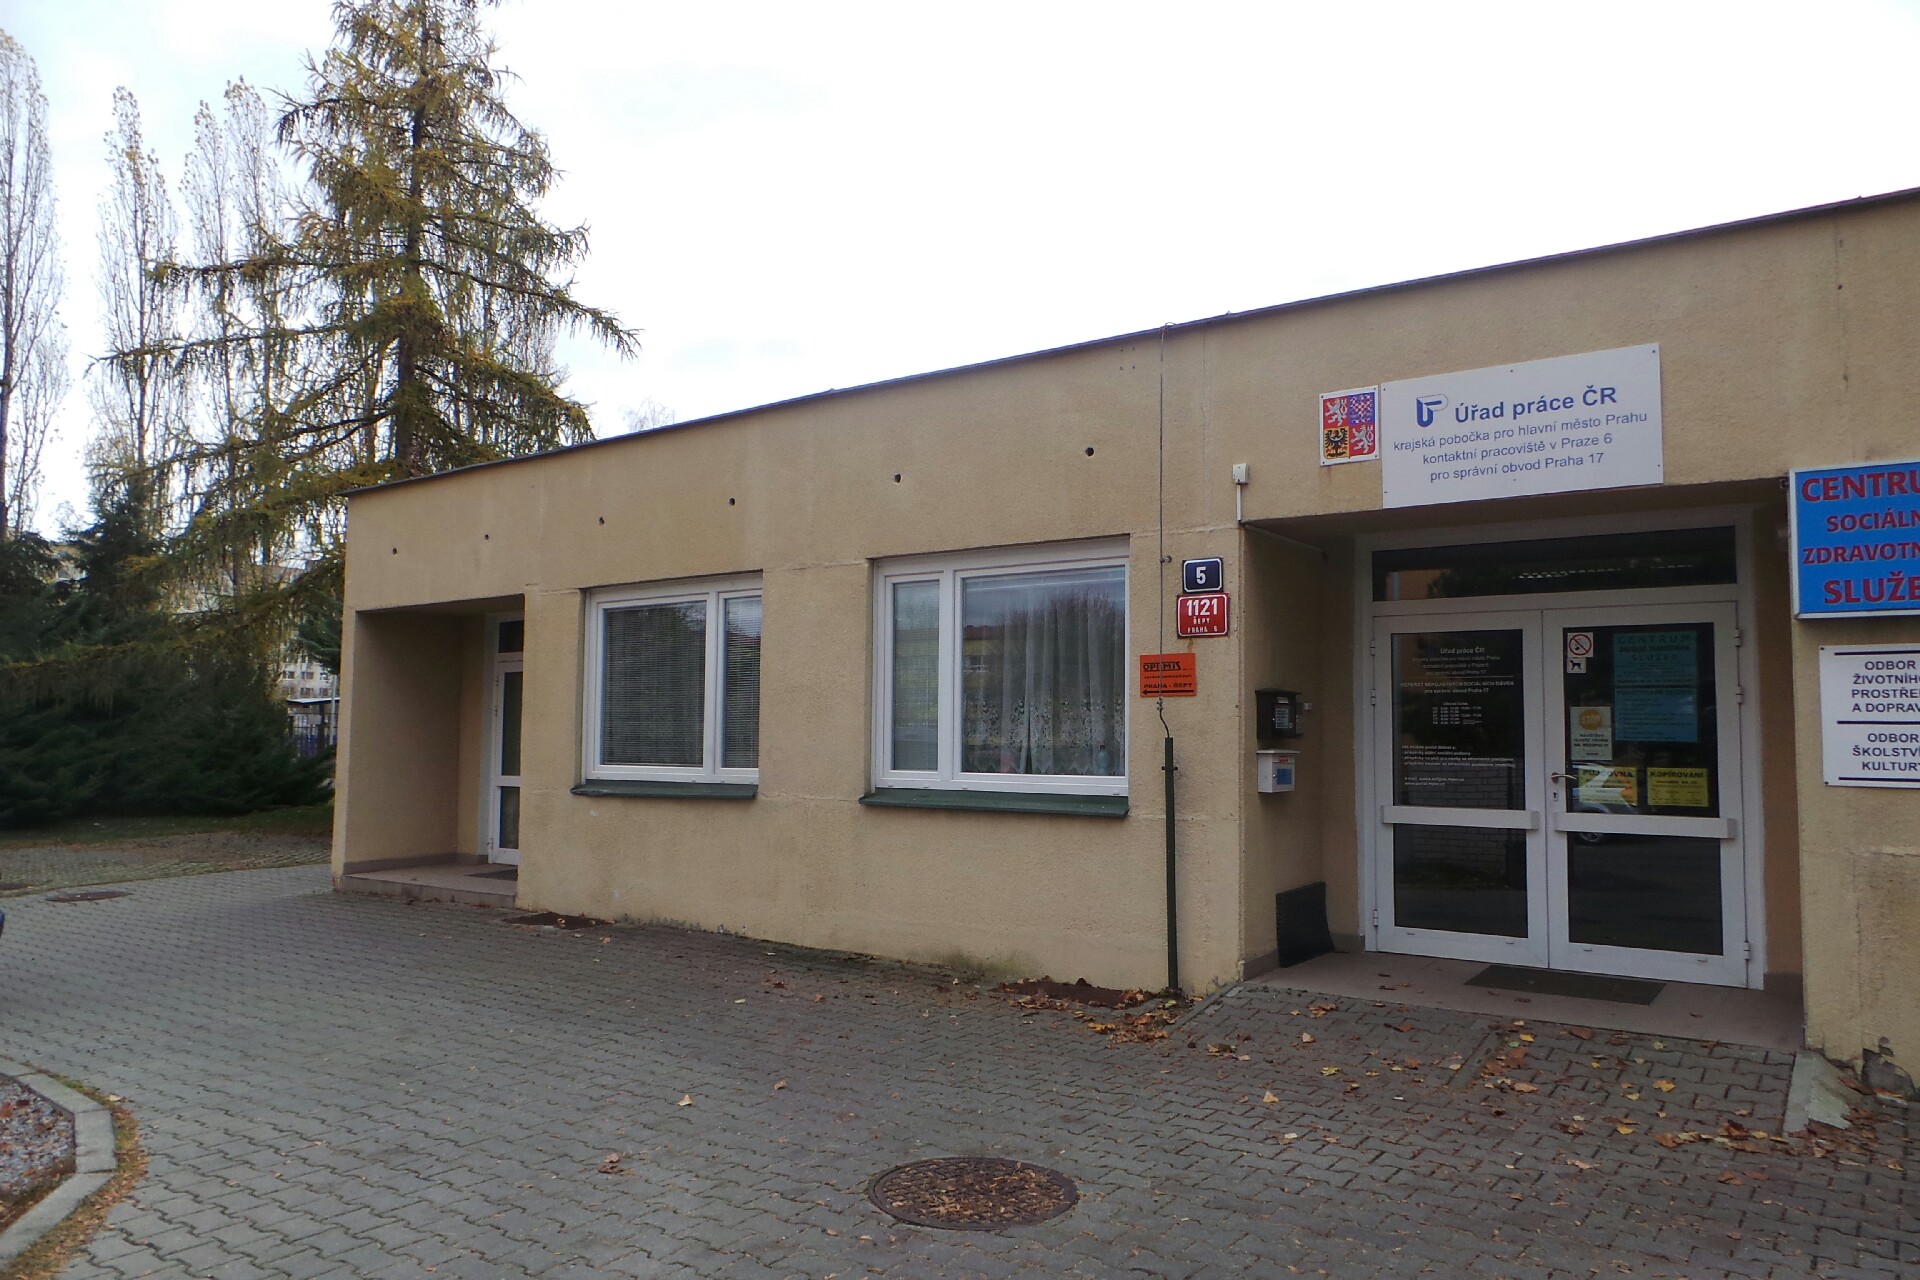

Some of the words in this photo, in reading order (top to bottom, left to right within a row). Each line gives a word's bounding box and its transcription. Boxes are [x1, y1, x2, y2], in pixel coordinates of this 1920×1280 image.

[1455, 401, 1505, 424] Úřad
[1512, 395, 1574, 421] práce
[1582, 385, 1618, 407] ČR
[1393, 436, 1436, 452] krajská
[1439, 430, 1490, 448] pobočka
[1494, 428, 1515, 442] pro
[1518, 421, 1557, 437] hlavní
[1561, 415, 1602, 431] město
[1606, 411, 1648, 426] Prahu
[1422, 448, 1478, 465] kontaktní
[1481, 440, 1546, 460] pracoviště
[1549, 441, 1557, 450] v
[1561, 435, 1600, 448] Praze
[1604, 432, 1613, 445] 6
[1430, 470, 1450, 483] pro
[1453, 464, 1498, 481] správní
[1502, 459, 1541, 474] obvod
[1545, 454, 1585, 469] Praha
[1589, 452, 1604, 465] 17
[1196, 567, 1206, 585] 5
[1824, 571, 1920, 605] SLUŽE
[1186, 598, 1218, 617] 1121
[1193, 616, 1210, 624] ŘEPY
[1865, 660, 1916, 671] ODBOR
[1852, 673, 1920, 685] ŽIVOTNÍH
[1851, 687, 1920, 699] PROSTŘE
[1852, 703, 1862, 713] A
[1867, 733, 1919, 743] ODBOR
[1862, 761, 1920, 771] KULTUR
